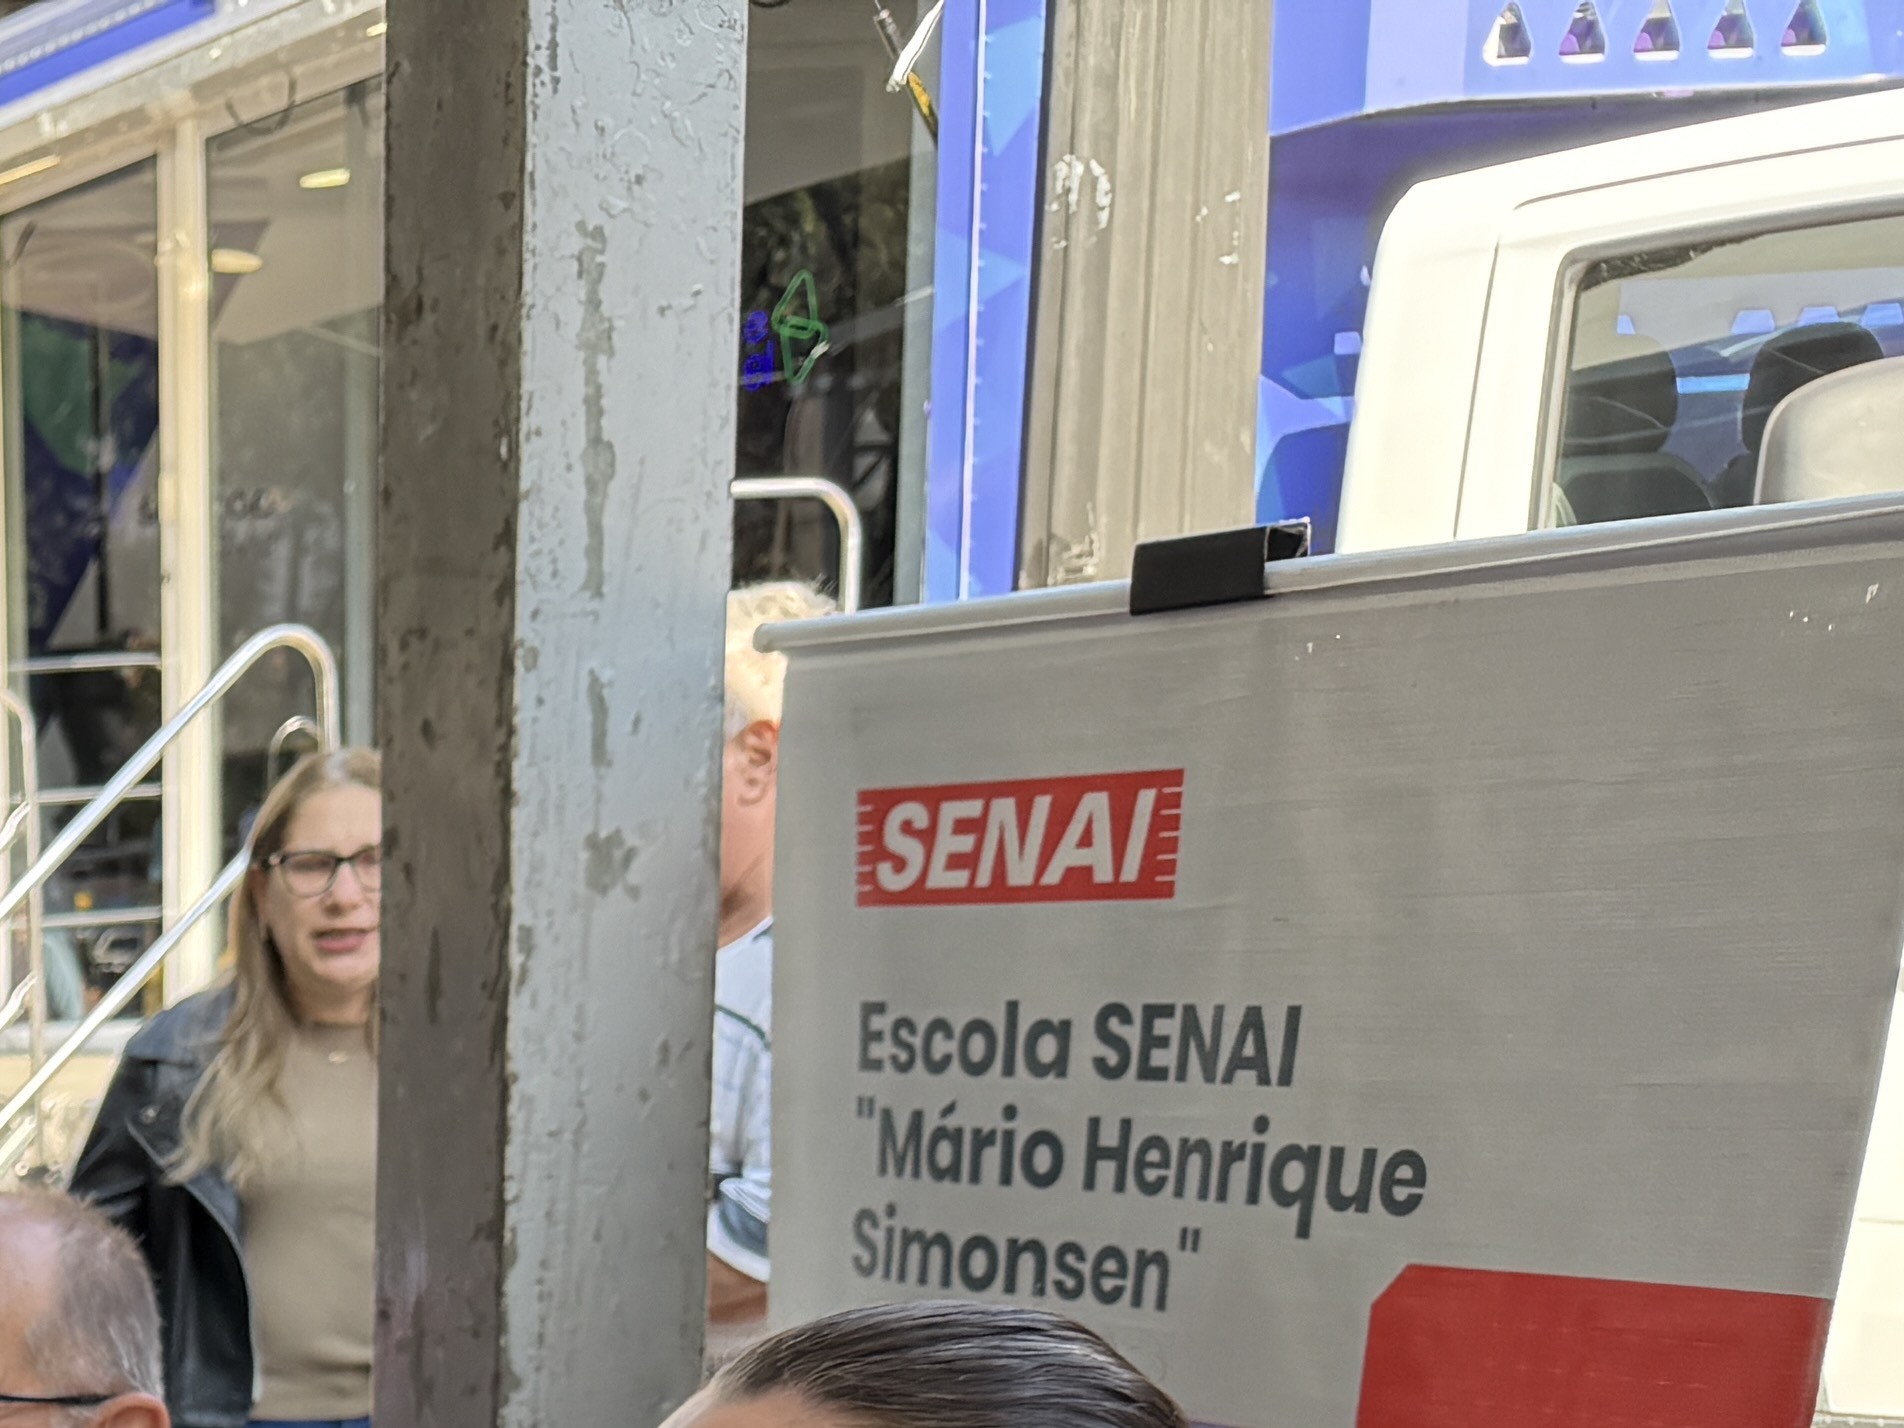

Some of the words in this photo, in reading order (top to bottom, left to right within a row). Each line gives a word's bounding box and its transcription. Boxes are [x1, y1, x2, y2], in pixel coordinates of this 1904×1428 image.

[877, 787, 1158, 892] SENAI
[859, 1000, 1071, 1078] Escola
[1092, 1002, 1302, 1088] SENAI
[857, 1097, 1063, 1188] "Mário
[1084, 1114, 1427, 1239] Henrique
[851, 1207, 1202, 1311] Simonsen"
